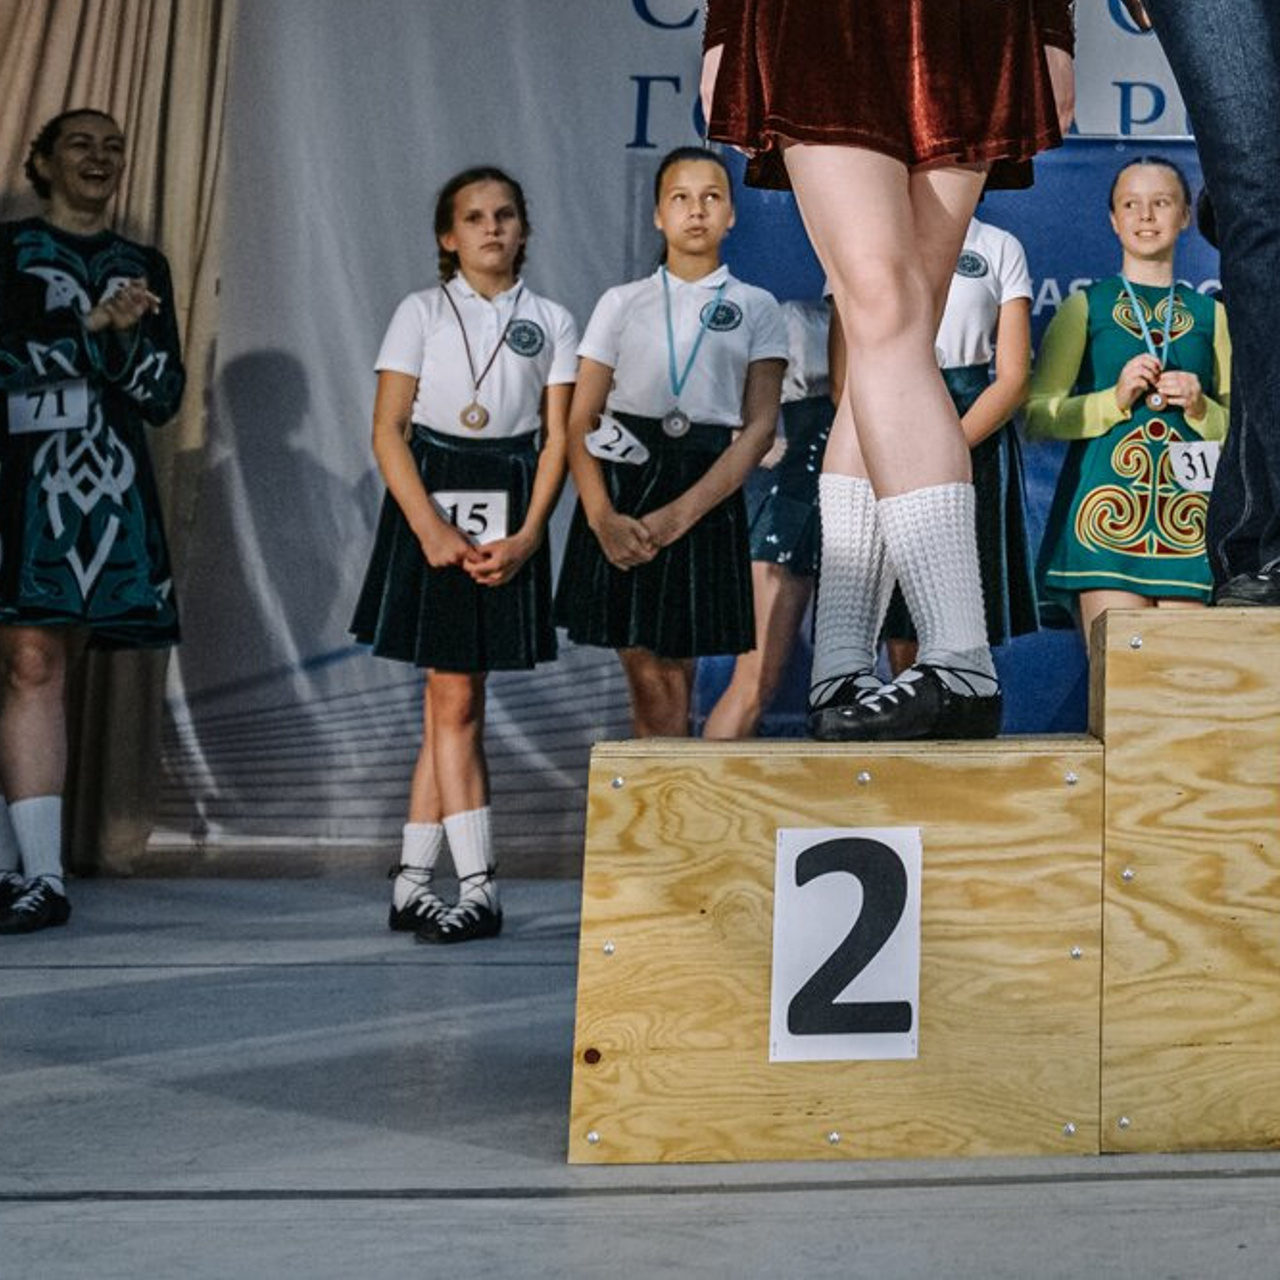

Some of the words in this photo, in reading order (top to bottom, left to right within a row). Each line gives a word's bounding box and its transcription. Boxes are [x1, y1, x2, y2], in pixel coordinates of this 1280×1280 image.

[26, 389, 66, 419] 71
[1181, 451, 1211, 480] 31
[446, 503, 488, 535] 15
[787, 838, 912, 1035] 2
